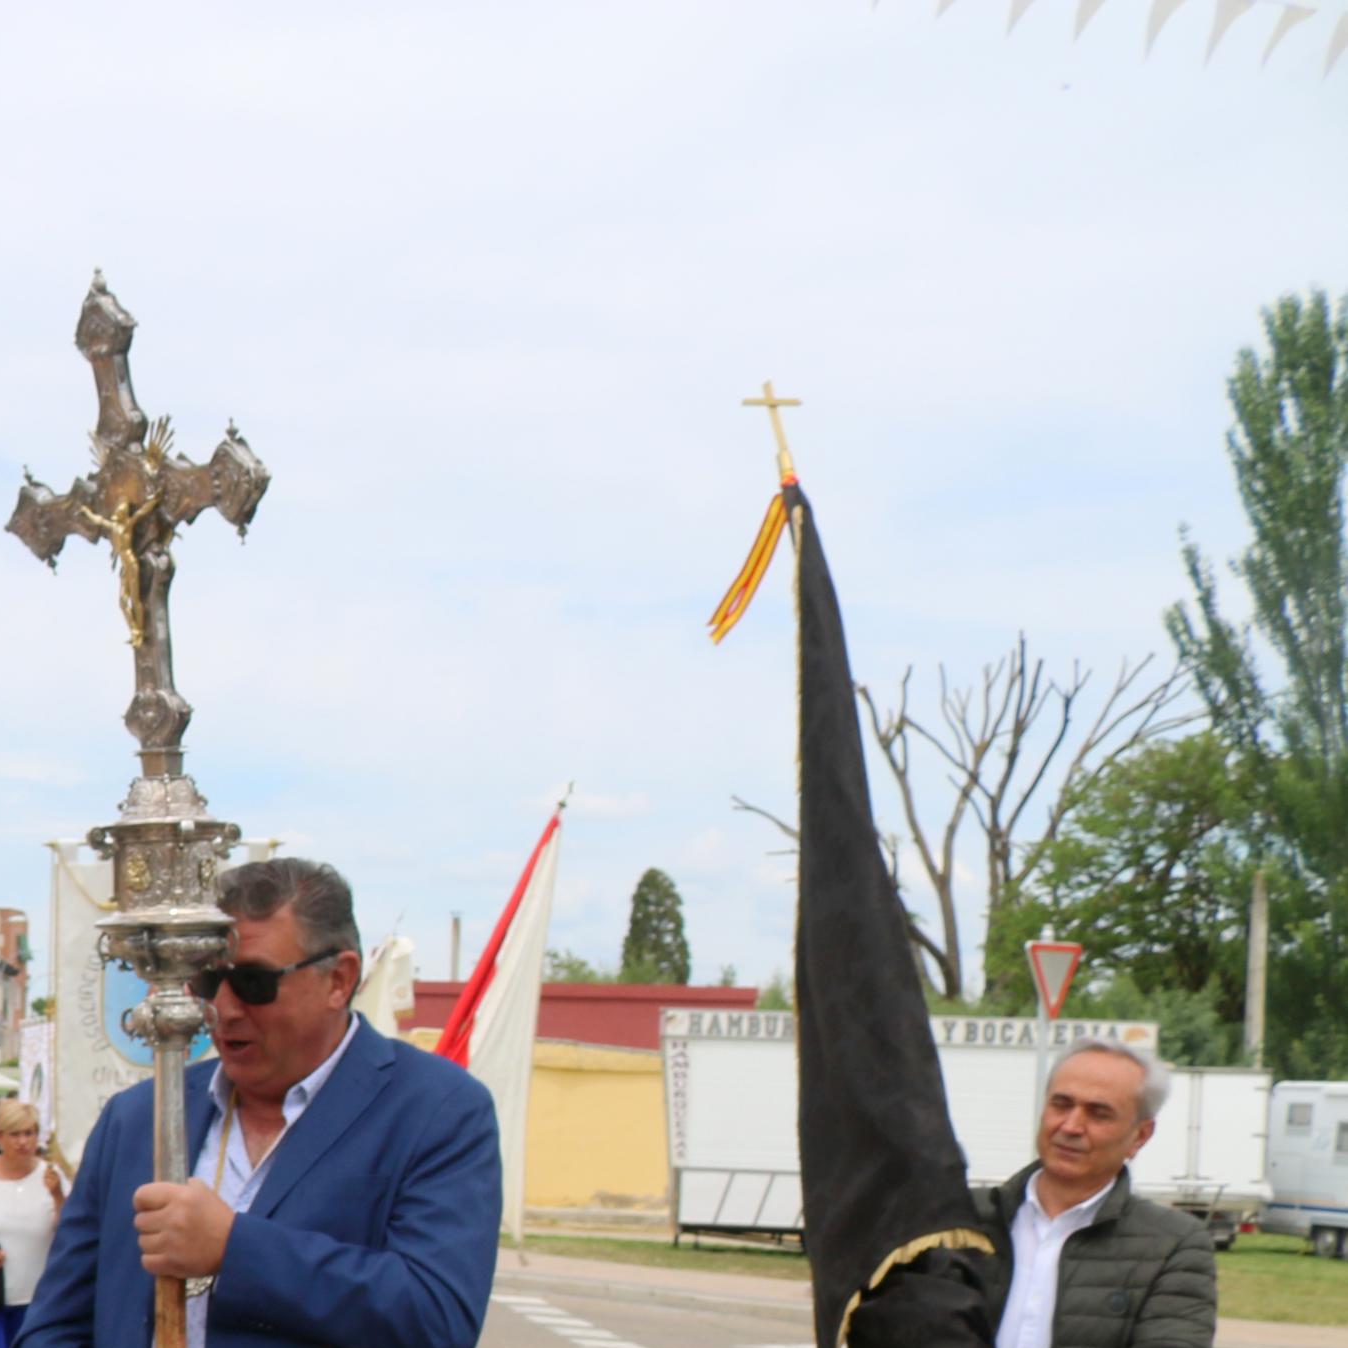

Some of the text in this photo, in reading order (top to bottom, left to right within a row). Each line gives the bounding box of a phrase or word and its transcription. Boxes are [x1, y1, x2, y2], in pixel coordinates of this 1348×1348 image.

[688, 1012, 1119, 1045] HAMBUR Y BOCAERIA
